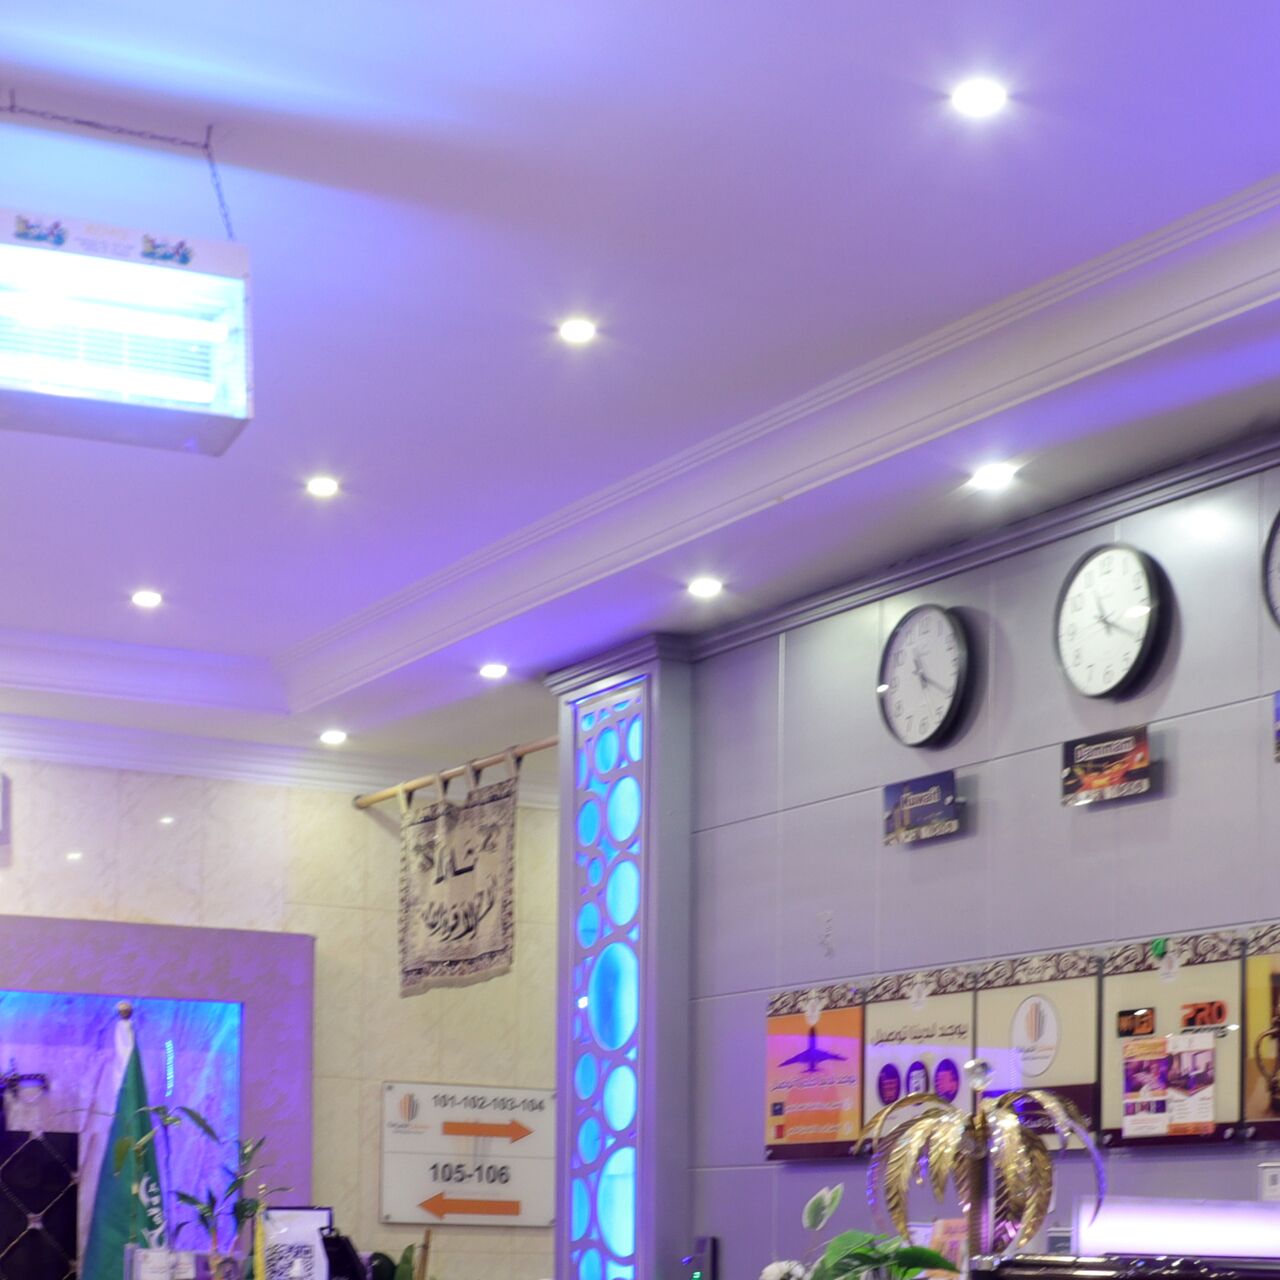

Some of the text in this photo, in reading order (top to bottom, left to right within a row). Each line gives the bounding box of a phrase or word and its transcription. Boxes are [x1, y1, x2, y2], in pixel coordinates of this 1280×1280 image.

[1181, 1001, 1230, 1027] PRO
[432, 1094, 545, 1113] 101-102-103-104
[429, 1162, 511, 1185] 105-106
